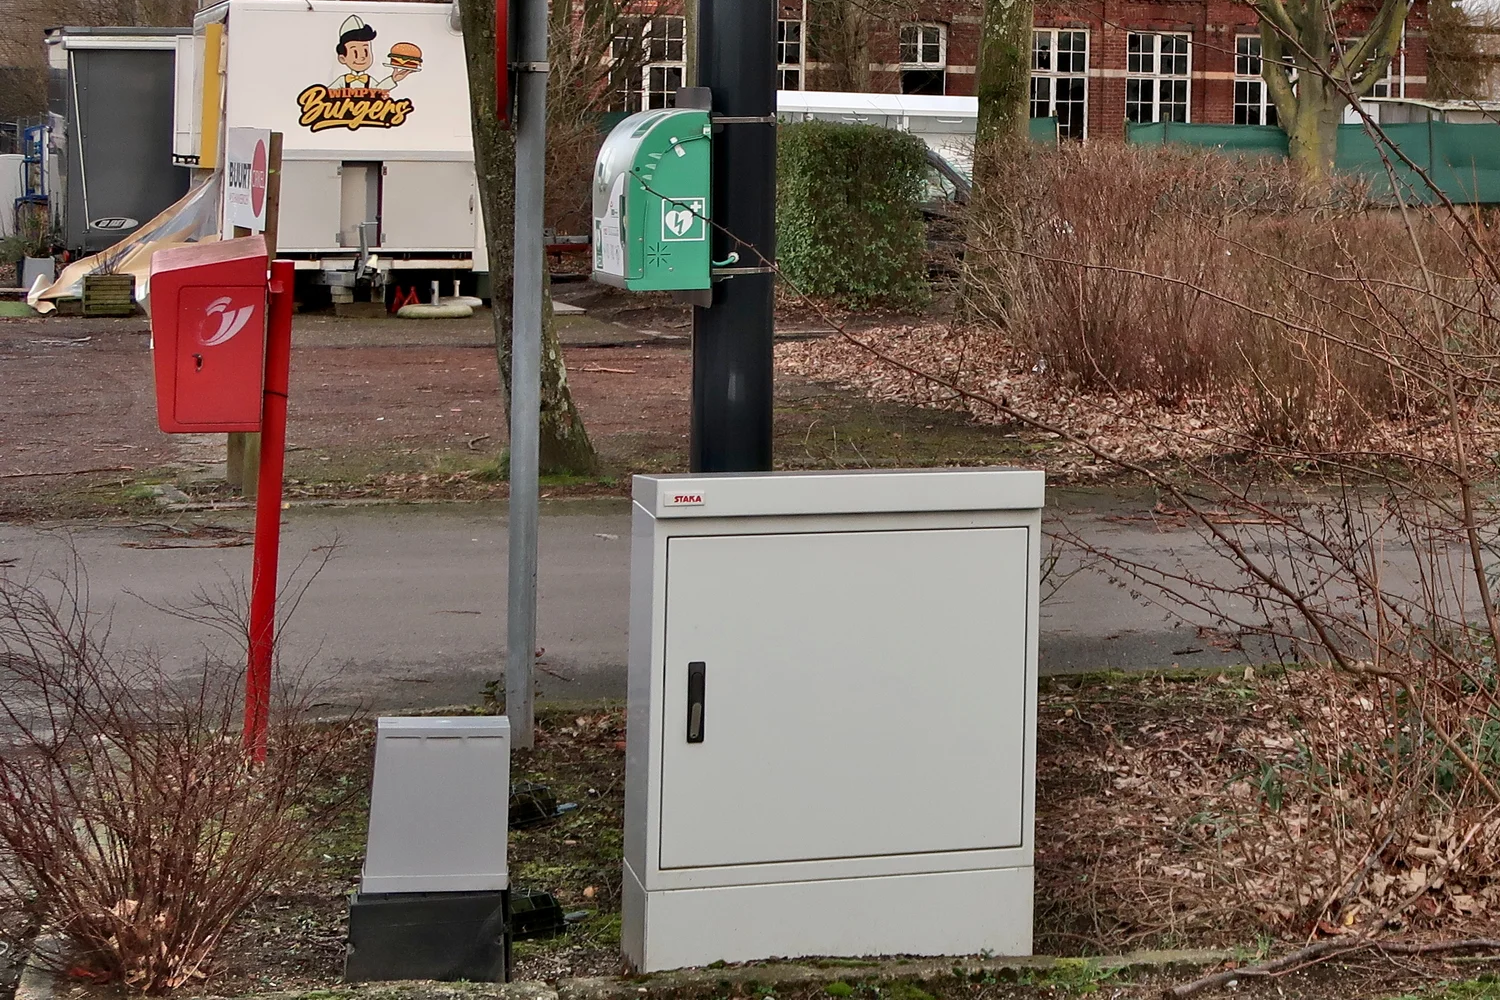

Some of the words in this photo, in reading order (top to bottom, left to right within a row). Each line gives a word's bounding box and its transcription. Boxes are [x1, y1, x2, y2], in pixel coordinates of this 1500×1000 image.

[327, 87, 391, 100] WIMPY'S
[298, 85, 413, 129] Burgers
[229, 161, 252, 190] BUURT
[673, 495, 702, 503] STAKA
